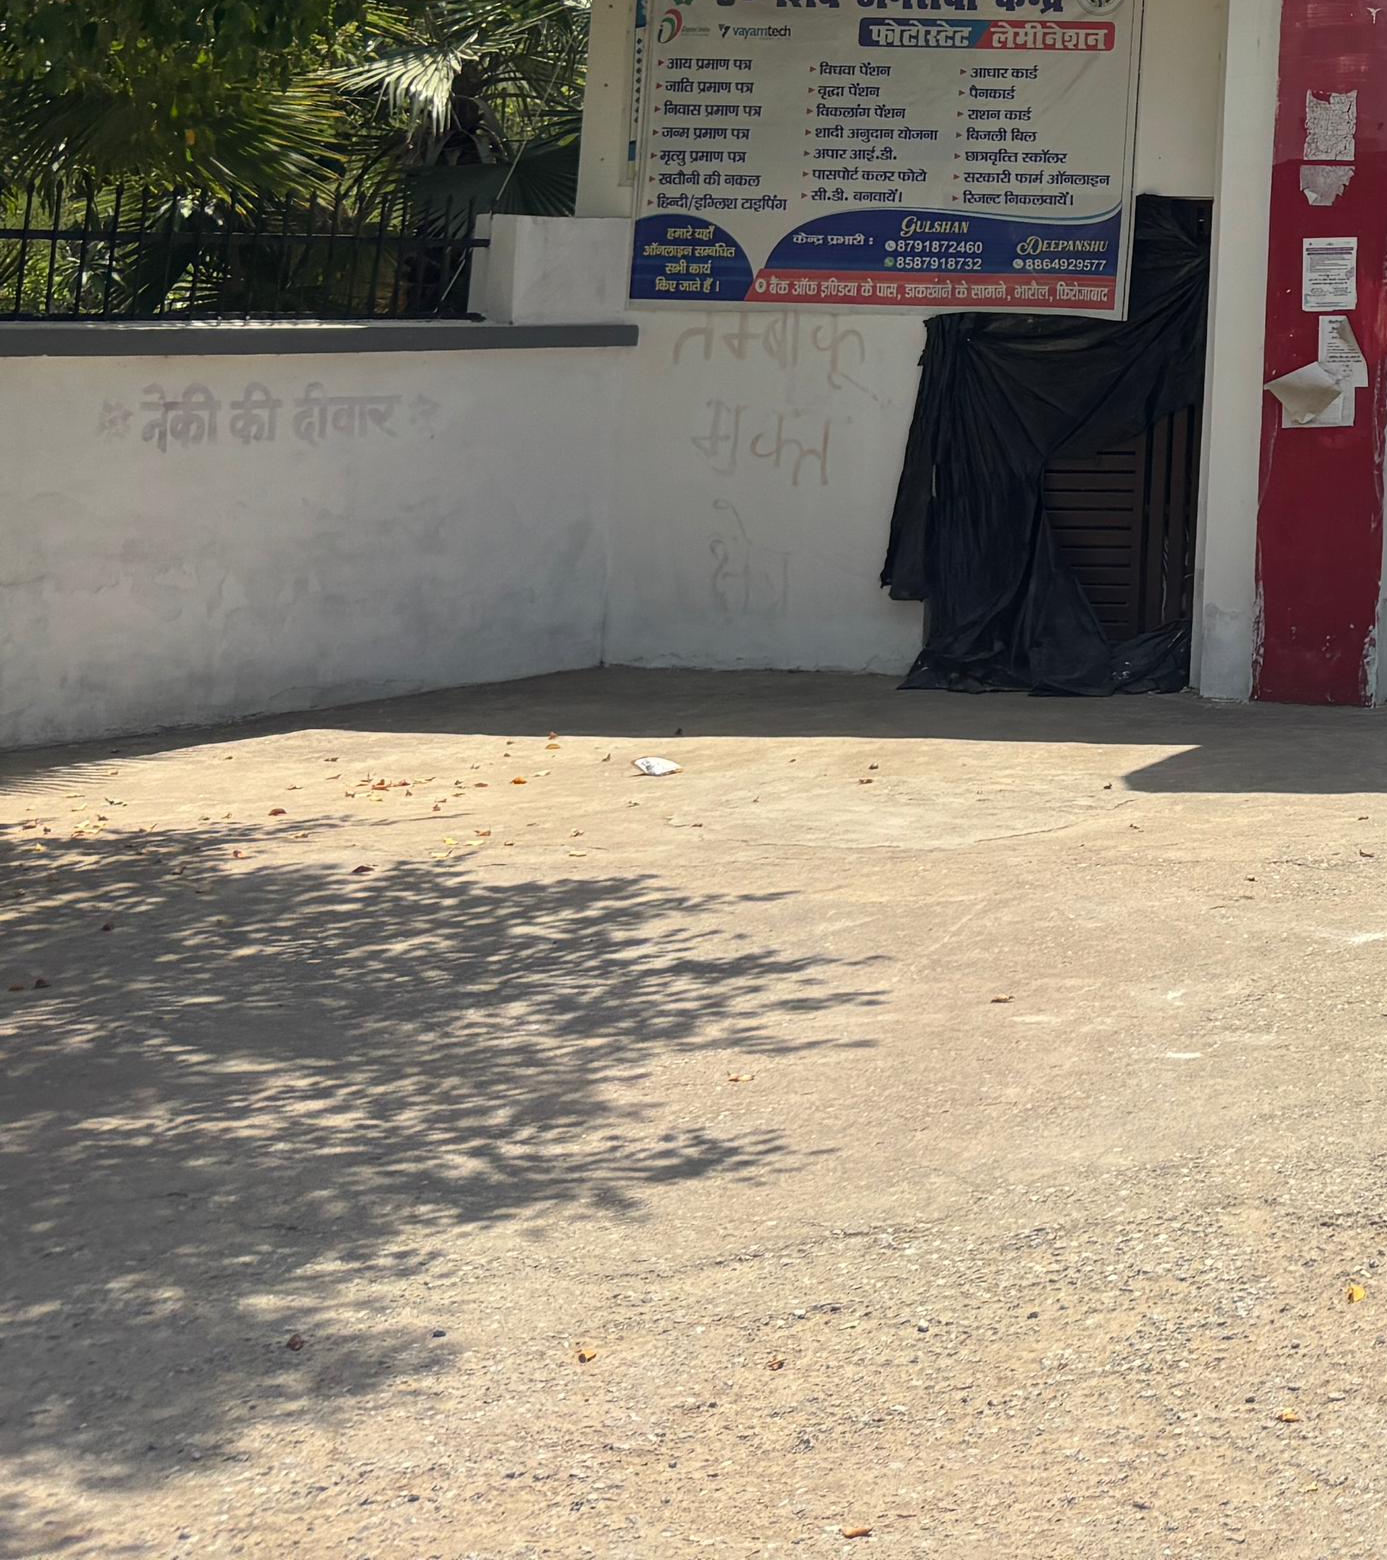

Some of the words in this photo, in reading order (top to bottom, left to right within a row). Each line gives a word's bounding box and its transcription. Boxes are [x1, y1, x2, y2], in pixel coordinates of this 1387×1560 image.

[732, 23, 791, 40] vayamtech
[869, 19, 972, 47] फोटोस्टेट
[990, 20, 1109, 50] लेमीनेशन
[667, 58, 692, 70] आय
[696, 58, 730, 71] प्रमाण
[734, 59, 752, 71] पत्र
[860, 62, 891, 76] पेंशन
[1011, 65, 1039, 79] कार्ड
[665, 77, 694, 92] जाति
[697, 81, 731, 94] प्रमाण
[735, 82, 754, 94] पत्र
[848, 83, 880, 97] पेंशन
[969, 85, 1016, 100] पैनकार्ड
[664, 100, 702, 116] निवास
[705, 104, 740, 117] प्रमाण
[743, 105, 762, 118] पत्र
[816, 103, 870, 118] विकलांग
[874, 104, 906, 119] पेंशन
[968, 109, 1000, 121] राशन
[1004, 107, 1032, 121] कार्ड
[662, 127, 690, 139] जन्म
[693, 127, 728, 140] प्रमाण
[731, 128, 750, 140] पत्र
[815, 124, 844, 139] शादी
[847, 128, 894, 142] अनुदान
[898, 126, 938, 140] योजना
[660, 150, 686, 166] मृत्यु
[689, 150, 724, 163] प्रमाण
[727, 151, 747, 163] पत्र
[813, 148, 848, 160] अपार
[1022, 149, 1068, 163] स्कॉलर
[659, 170, 700, 186] खतौनी
[703, 170, 721, 186] की
[724, 174, 762, 187] नकल
[812, 167, 858, 181] पासपोर्ट
[862, 170, 897, 182] कलर
[898, 168, 927, 182] फोटो
[963, 170, 1011, 184] सरकारी
[1015, 170, 1044, 184] फार्म
[1047, 171, 1110, 187] ऑनलाइन
[741, 194, 787, 212] टाइपिंग
[792, 232, 824, 245] केन्द्र
[828, 233, 864, 246] प्रभारी
[643, 243, 692, 258] ऑनलाइन
[897, 240, 983, 254] 8791872460
[665, 261, 686, 274] सभी
[689, 260, 711, 274] कार्य
[896, 256, 983, 270] 8587918732
[1025, 257, 1107, 271] 8864929577
[655, 277, 677, 292] किए
[680, 277, 701, 293] जाते
[820, 280, 857, 298] इण्डिया
[861, 278, 873, 296] के
[955, 280, 967, 298] के
[229, 382, 283, 445] की
